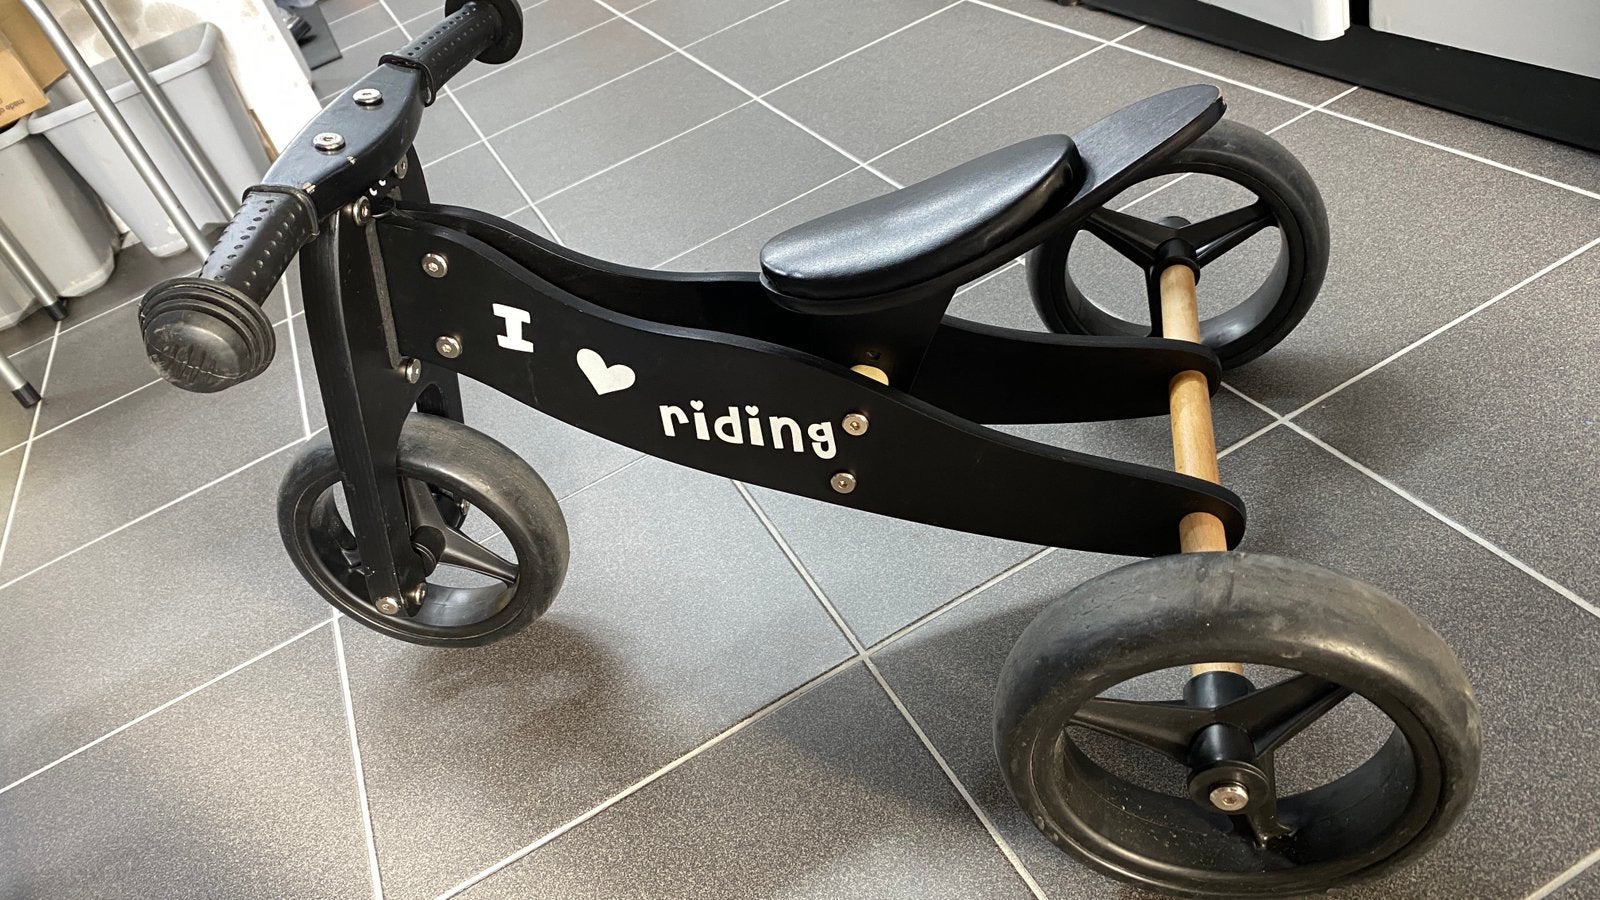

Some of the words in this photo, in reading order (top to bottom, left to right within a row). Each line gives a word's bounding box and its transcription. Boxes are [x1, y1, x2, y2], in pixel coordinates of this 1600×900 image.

[5, 98, 25, 110] made
[492, 303, 534, 353] I
[659, 400, 837, 460] riding
